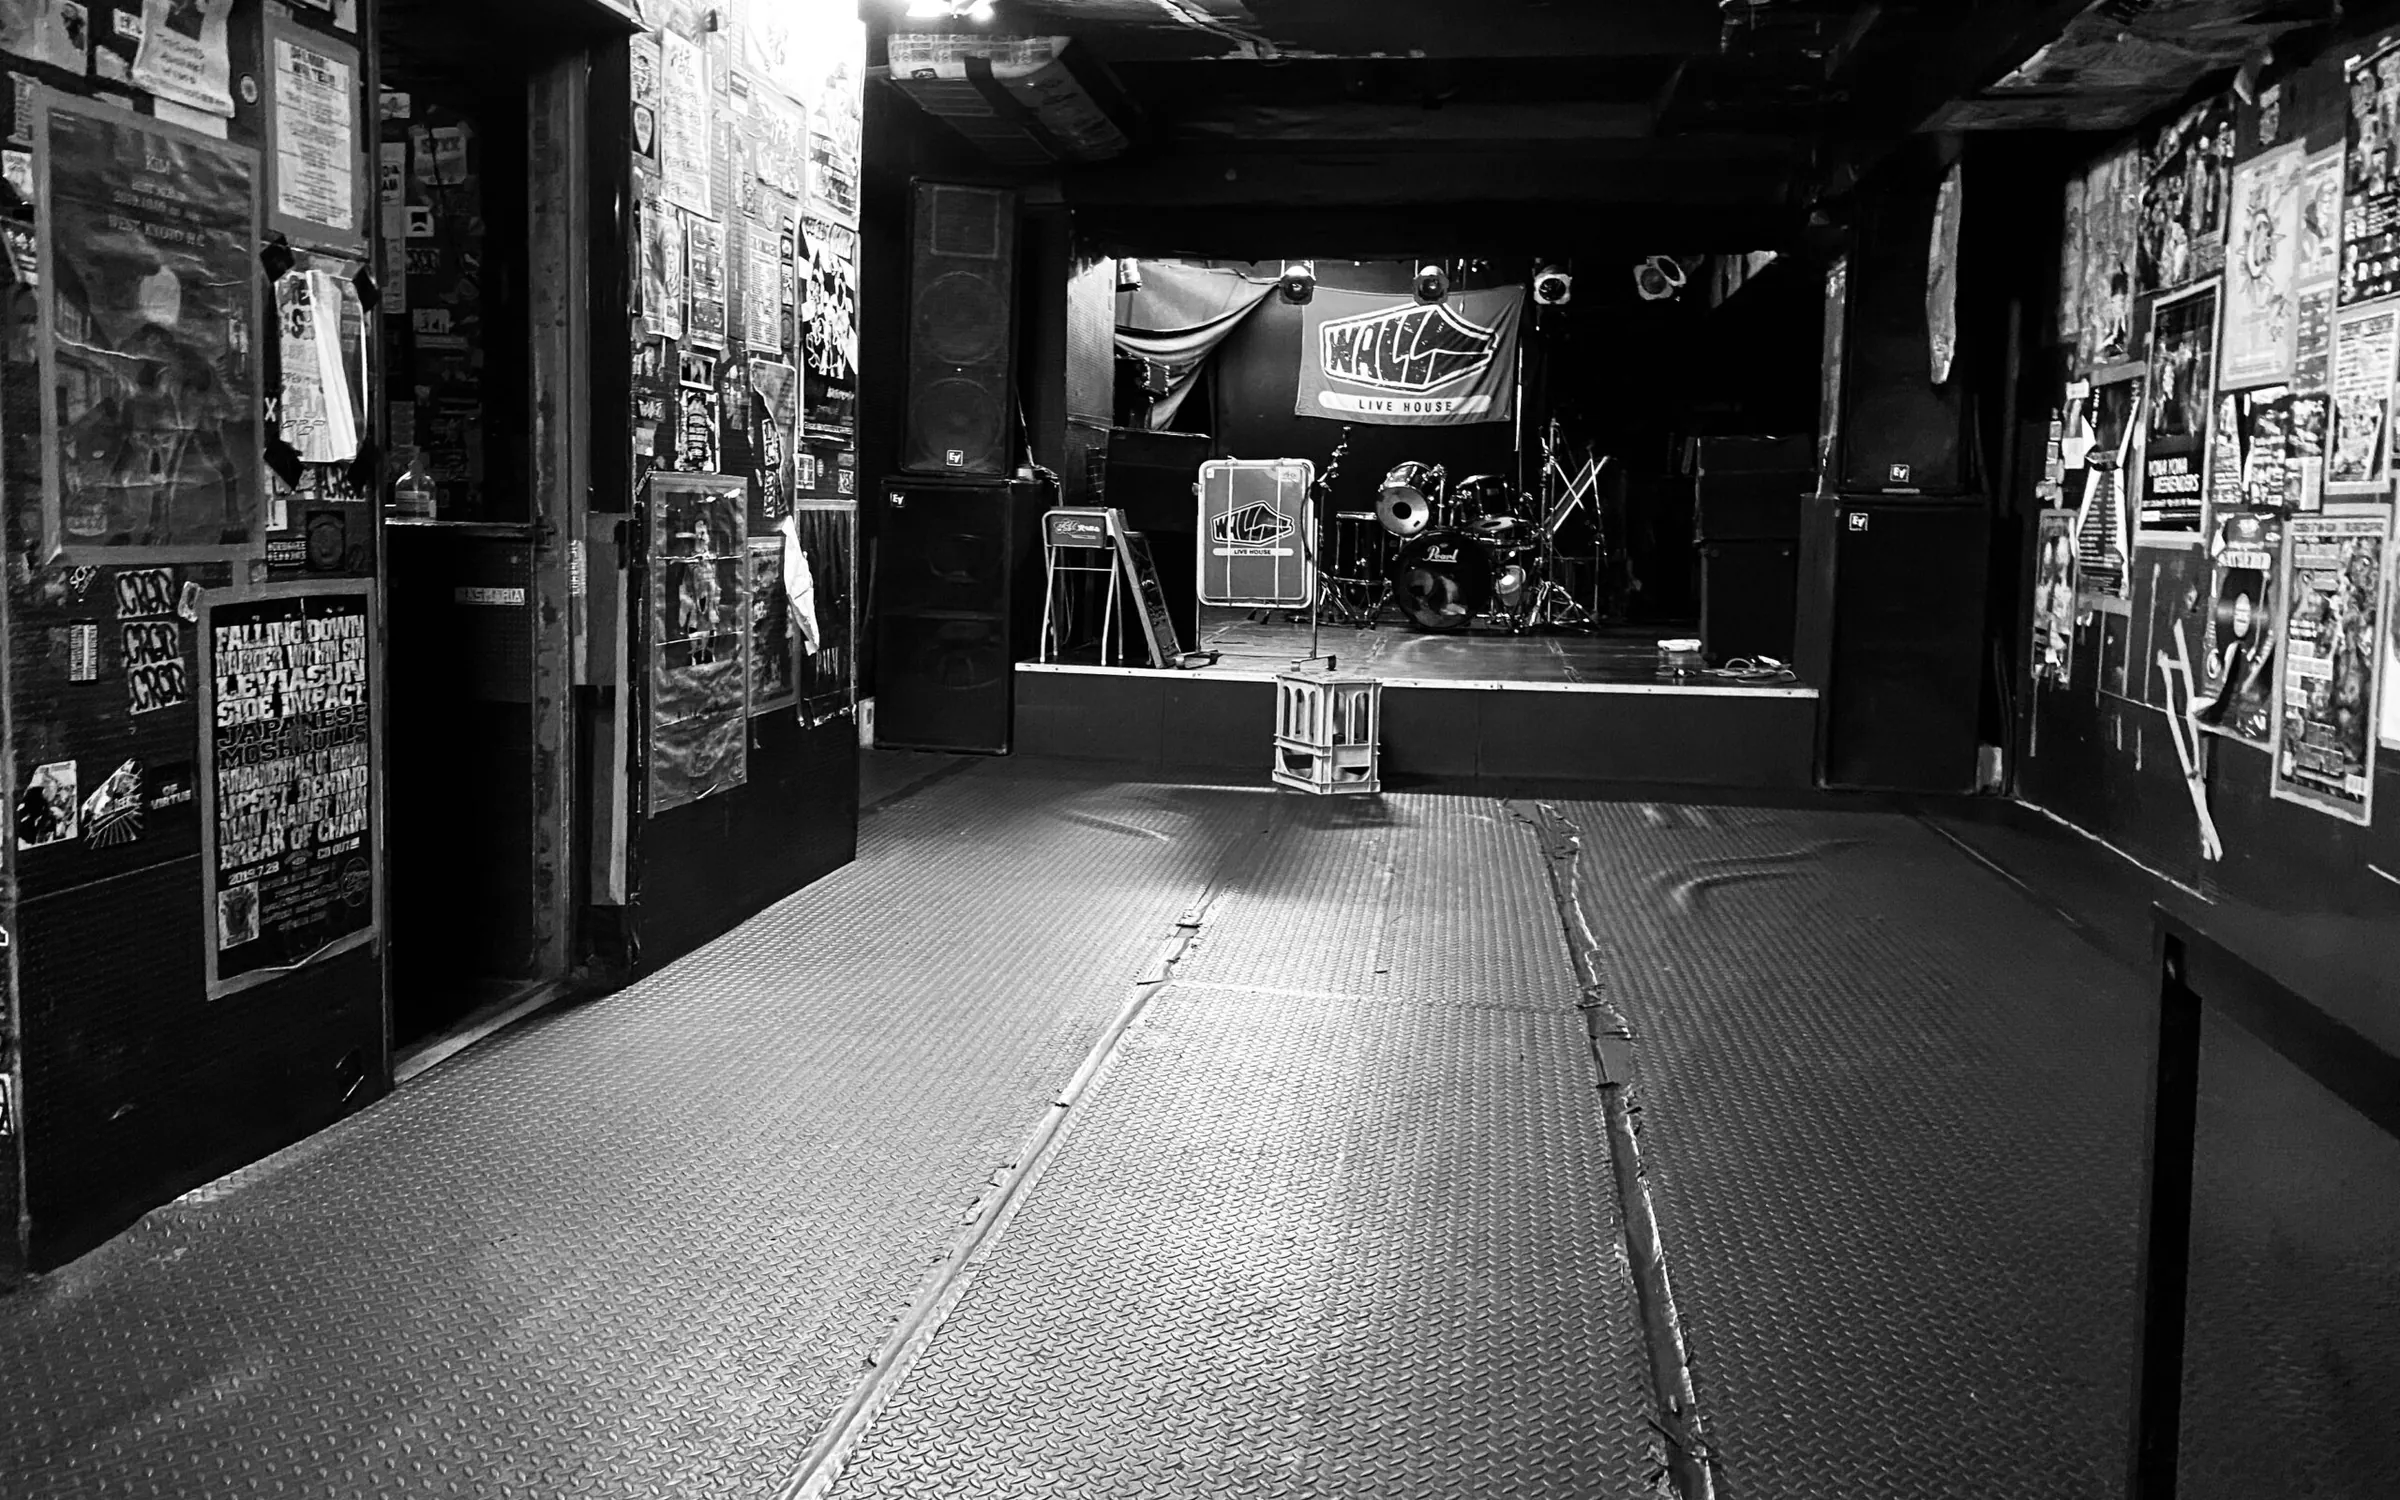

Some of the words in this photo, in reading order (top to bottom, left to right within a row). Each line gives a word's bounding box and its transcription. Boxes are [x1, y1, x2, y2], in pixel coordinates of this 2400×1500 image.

[1358, 399, 1393, 412] LIVE
[1403, 399, 1453, 413] HOUSE
[1422, 544, 1459, 563] Pearl
[215, 620, 302, 652] FALLING
[307, 615, 365, 642] DOWN
[217, 695, 275, 727] SIDE
[281, 681, 367, 716] IMPACT
[217, 702, 368, 748] JAPANESE
[220, 782, 291, 820] UPSET
[297, 765, 369, 803] BEHIND
[220, 829, 286, 871] BREAK
[289, 823, 314, 850] OF
[317, 808, 368, 843] CHAIN
